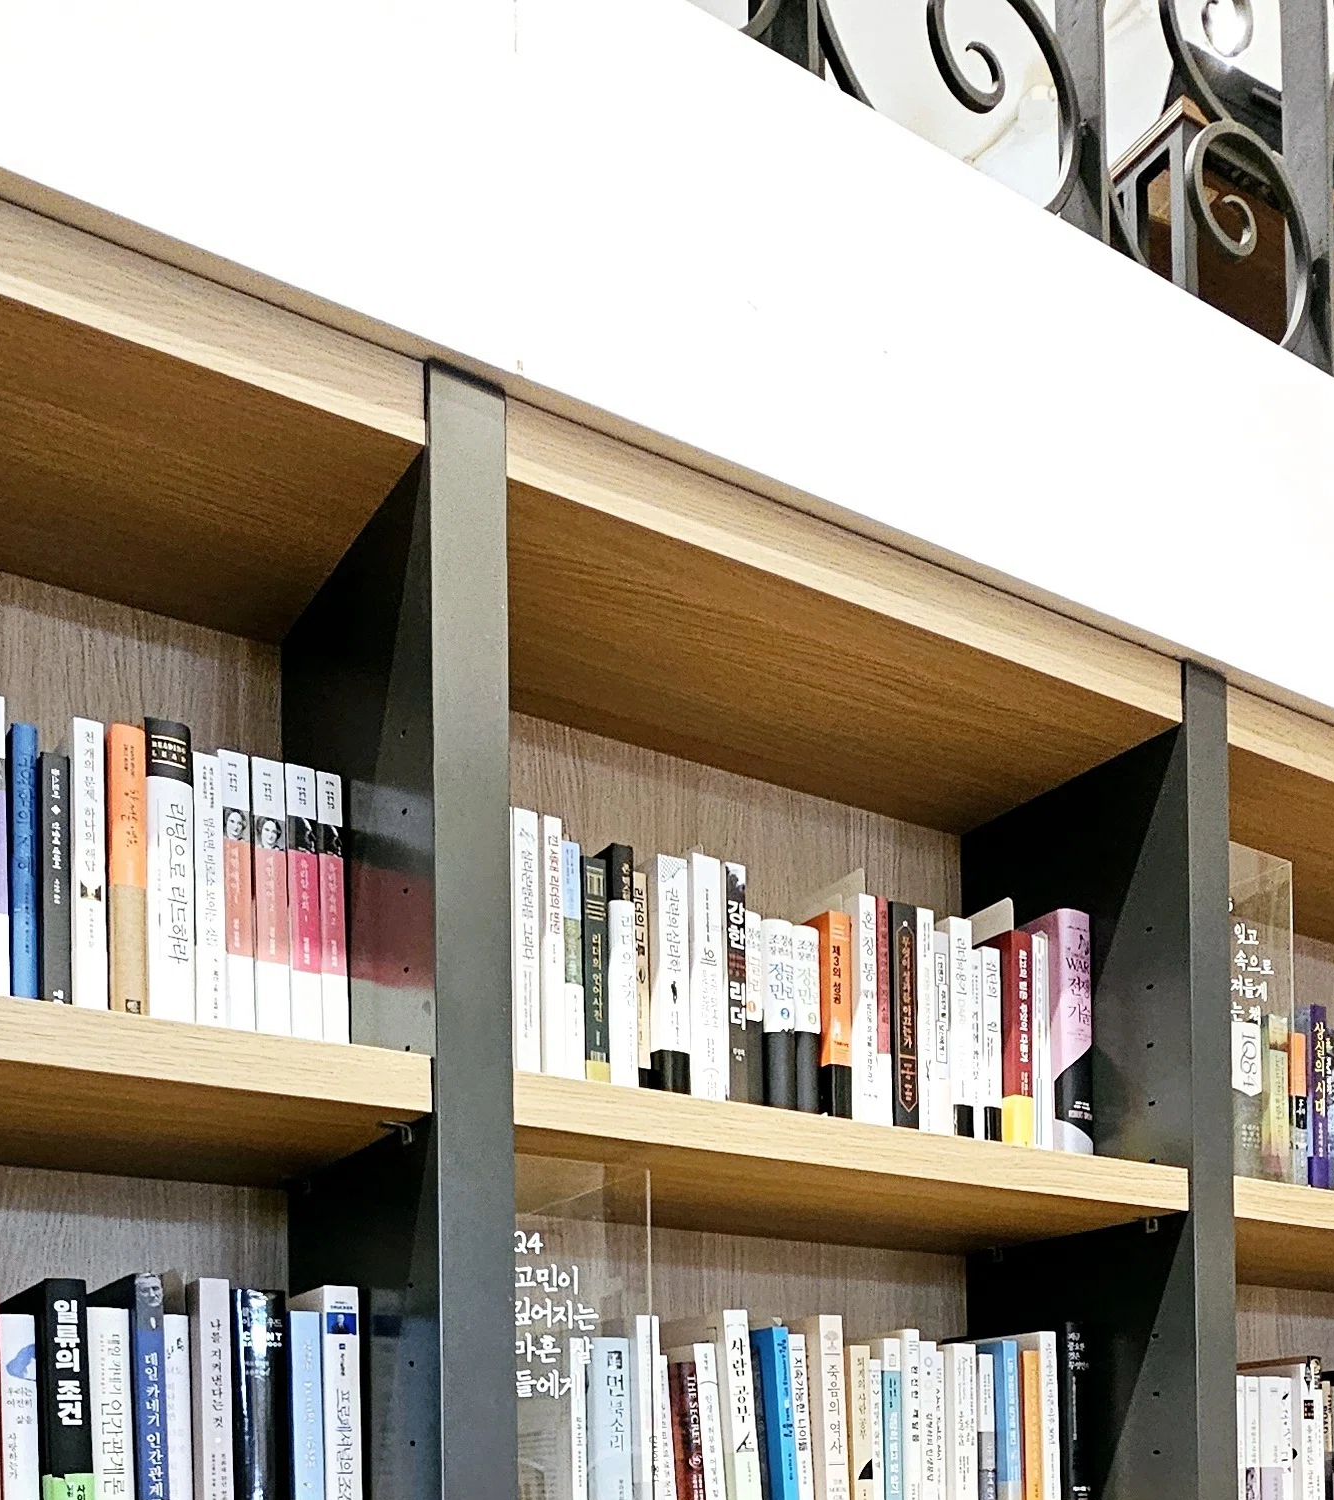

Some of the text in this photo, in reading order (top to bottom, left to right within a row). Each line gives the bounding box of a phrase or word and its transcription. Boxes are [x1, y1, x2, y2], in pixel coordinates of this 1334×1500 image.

[167, 803, 189, 963] 리딩으로 리드하라
[665, 887, 681, 975] 권력의 심리학
[728, 901, 746, 950] 강한
[1233, 923, 1259, 945] 잊고
[1233, 950, 1275, 975] 속으로
[730, 981, 746, 1031] 리더
[1230, 974, 1268, 1002] 져들게
[1314, 1021, 1326, 1118] 상실의 시대
[515, 1264, 579, 1295] 고민이
[515, 1297, 600, 1331] 깊어지는
[53, 1300, 83, 1427] 일류의 조건
[515, 1333, 561, 1364] 마흔
[730, 1336, 747, 1377] 사람
[516, 1369, 582, 1400] 들에게
[793, 1356, 808, 1452] 지속가능한 나이듦
[827, 1364, 843, 1454] 죽음의 역사
[335, 1388, 353, 1475] 프로페셔널의
[606, 1374, 627, 1453] 먼 북소리
[687, 1375, 701, 1446] THE SECRET
